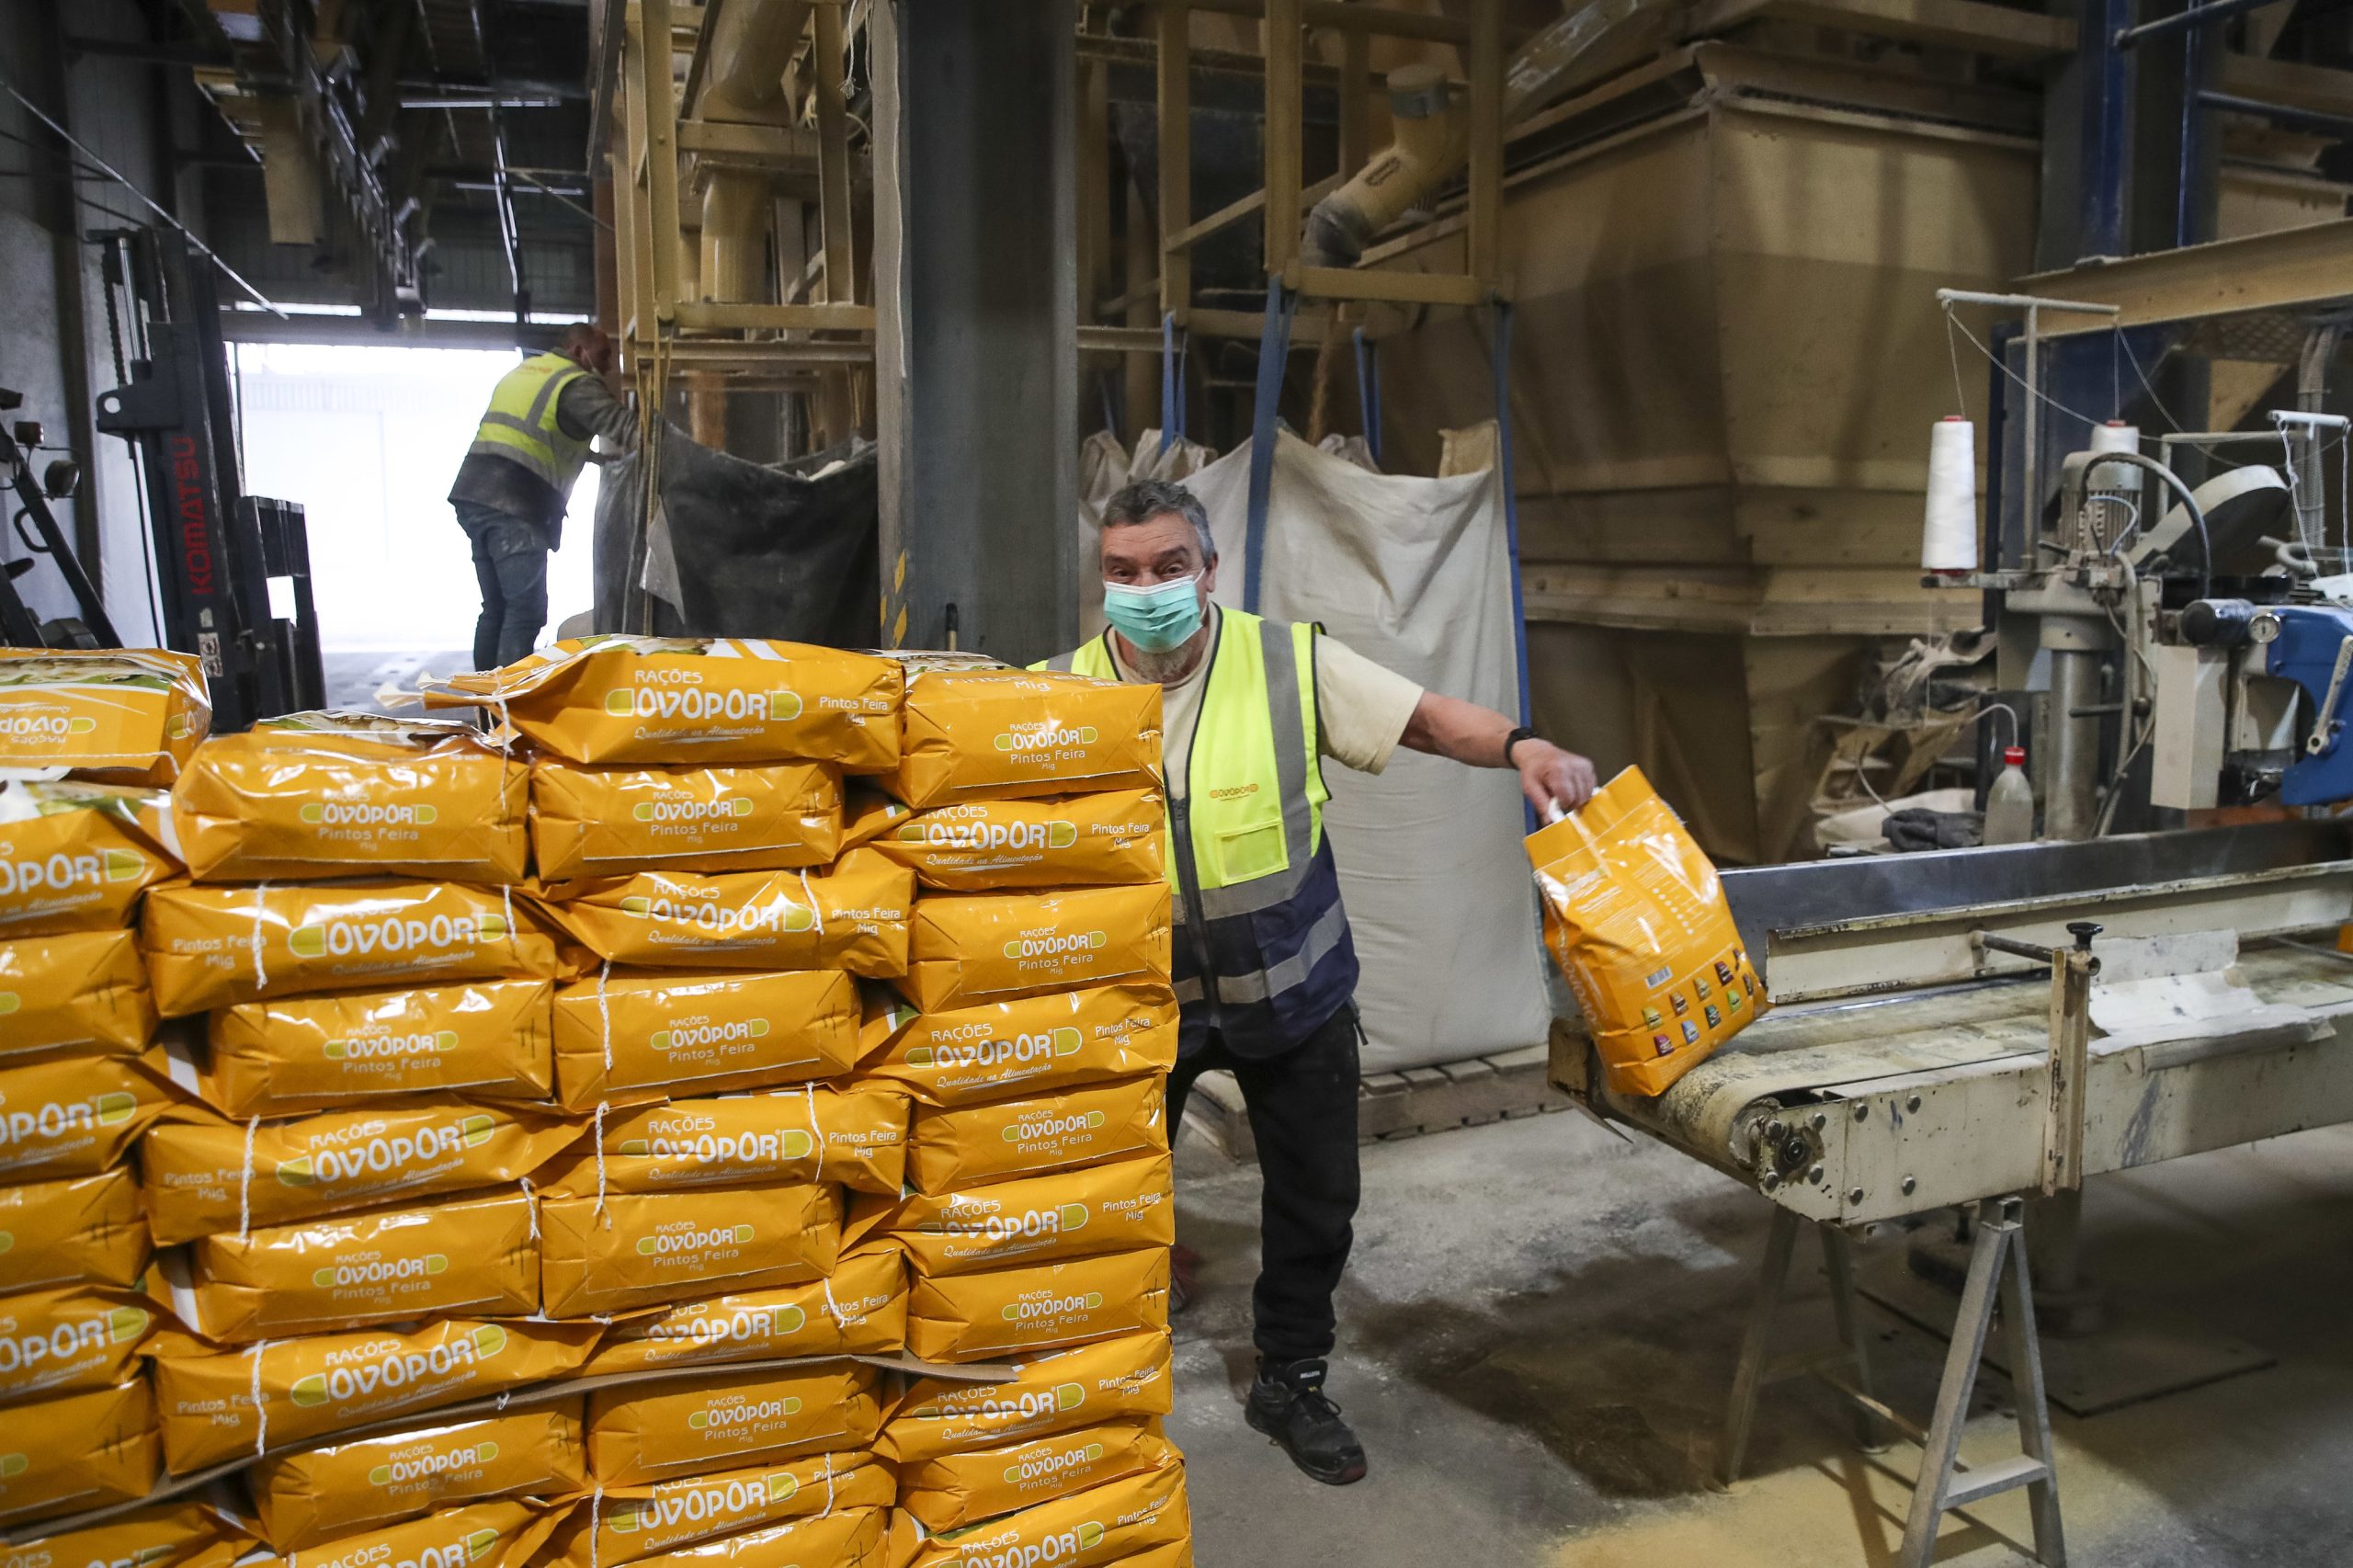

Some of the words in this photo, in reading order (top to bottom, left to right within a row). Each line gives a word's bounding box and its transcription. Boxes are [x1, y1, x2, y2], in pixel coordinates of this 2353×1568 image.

[172, 437, 215, 595] KOMATSU
[634, 668, 703, 687] RAÇÕES
[1015, 680, 1051, 692] Mig
[637, 687, 767, 721] OVOPOR
[819, 696, 859, 709] Pintos
[862, 697, 888, 710] Feira
[1010, 722, 1045, 732] RAÇÕES
[1012, 728, 1080, 751] OVOPOR
[1010, 752, 1051, 764] Pintos
[1055, 749, 1086, 761] Feira
[323, 803, 413, 824] OVOPOR
[654, 800, 732, 821] OVOPOR
[318, 828, 371, 840] Pintos
[379, 828, 418, 840] Feira
[651, 824, 698, 836] Pintos
[702, 822, 738, 834] Feira
[928, 820, 1044, 850] OVOPOR
[1092, 823, 1125, 835] Pintos
[1128, 823, 1149, 833] Feira
[926, 854, 974, 866] Qualidade
[988, 853, 1043, 864] Alimentação
[653, 898, 778, 934] OVOPOR
[832, 908, 870, 918] Pintos
[872, 907, 901, 918] Feira
[328, 915, 475, 955] OVOPOR
[858, 924, 879, 936] Mig
[1020, 926, 1056, 937] RAÇÕES
[173, 938, 222, 951] Pintos
[1022, 935, 1088, 956] OVOPOR
[206, 953, 234, 969] Mig
[1018, 959, 1059, 971] Pintos
[1064, 954, 1093, 965] Feira
[670, 1016, 710, 1027] RAÇÕES
[1096, 1022, 1123, 1037] Pintos
[1125, 1017, 1150, 1028] Feira
[672, 1022, 747, 1048] OVOPOR
[932, 1024, 993, 1042] RAÇÕES
[1114, 1034, 1130, 1046] Mig
[347, 1033, 434, 1058] OVOPOR
[669, 1050, 714, 1062] Pintos
[721, 1044, 755, 1055] Feira
[937, 1033, 1051, 1068] OVOPOR
[343, 1061, 395, 1073] Pintos
[401, 1057, 441, 1070] Feira
[937, 1075, 984, 1089] Qualidade
[1001, 1063, 1051, 1079] Alimentação
[1017, 1110, 1053, 1122] RAÇÕES
[310, 1119, 386, 1149] RAÇÕES
[649, 1117, 715, 1136] RAÇÕES
[1020, 1115, 1086, 1140] OVOPOR
[829, 1132, 866, 1144] Pintos
[870, 1131, 897, 1142] Feira
[1017, 1140, 1057, 1154] Pintos
[1063, 1134, 1092, 1146] Feira
[314, 1126, 461, 1183] OVOPOR
[653, 1131, 777, 1164] OVOPOR
[854, 1147, 872, 1158] Mig
[164, 1172, 212, 1185] Pintos
[941, 1199, 1001, 1219] RAÇÕES
[1103, 1199, 1136, 1212] Pintos
[1125, 1210, 1144, 1221] Mig
[656, 1221, 696, 1233] RAÇÕES
[657, 1228, 733, 1254] OVOPOR
[654, 1253, 699, 1267] Pintos
[704, 1249, 739, 1261] Feira
[944, 1244, 988, 1257] Qualidade
[336, 1258, 424, 1286] OVOPOR
[333, 1288, 385, 1300] Pintos
[391, 1281, 431, 1293] Feira
[1019, 1290, 1052, 1301] RAÇÕES
[863, 1294, 889, 1307] Feira
[1020, 1296, 1085, 1318] OVOPOR
[1016, 1320, 1054, 1331] Pintos
[1059, 1313, 1088, 1324] Feira
[325, 1339, 402, 1367] RAÇÕES
[330, 1338, 474, 1401] OVOPOR
[707, 1395, 746, 1408] RAÇÕES
[938, 1385, 997, 1403] RAÇÕES
[176, 1400, 225, 1413] Pintos
[709, 1401, 781, 1426] OVOPOR
[705, 1426, 748, 1441] Pintos
[753, 1420, 787, 1433] Feira
[390, 1443, 434, 1460] RAÇÕES
[1018, 1448, 1051, 1461] RAÇÕES
[392, 1449, 476, 1482] OVOPOR
[1021, 1449, 1086, 1479] OVOPOR
[445, 1469, 483, 1483] Feira
[1019, 1477, 1057, 1492] Pintos
[1063, 1466, 1091, 1479] Feira
[641, 1482, 765, 1528] OVOPOR
[644, 1531, 695, 1550] Qualidade
[712, 1511, 767, 1532] Alimentação
[961, 1530, 1019, 1555] RAÇÕES
